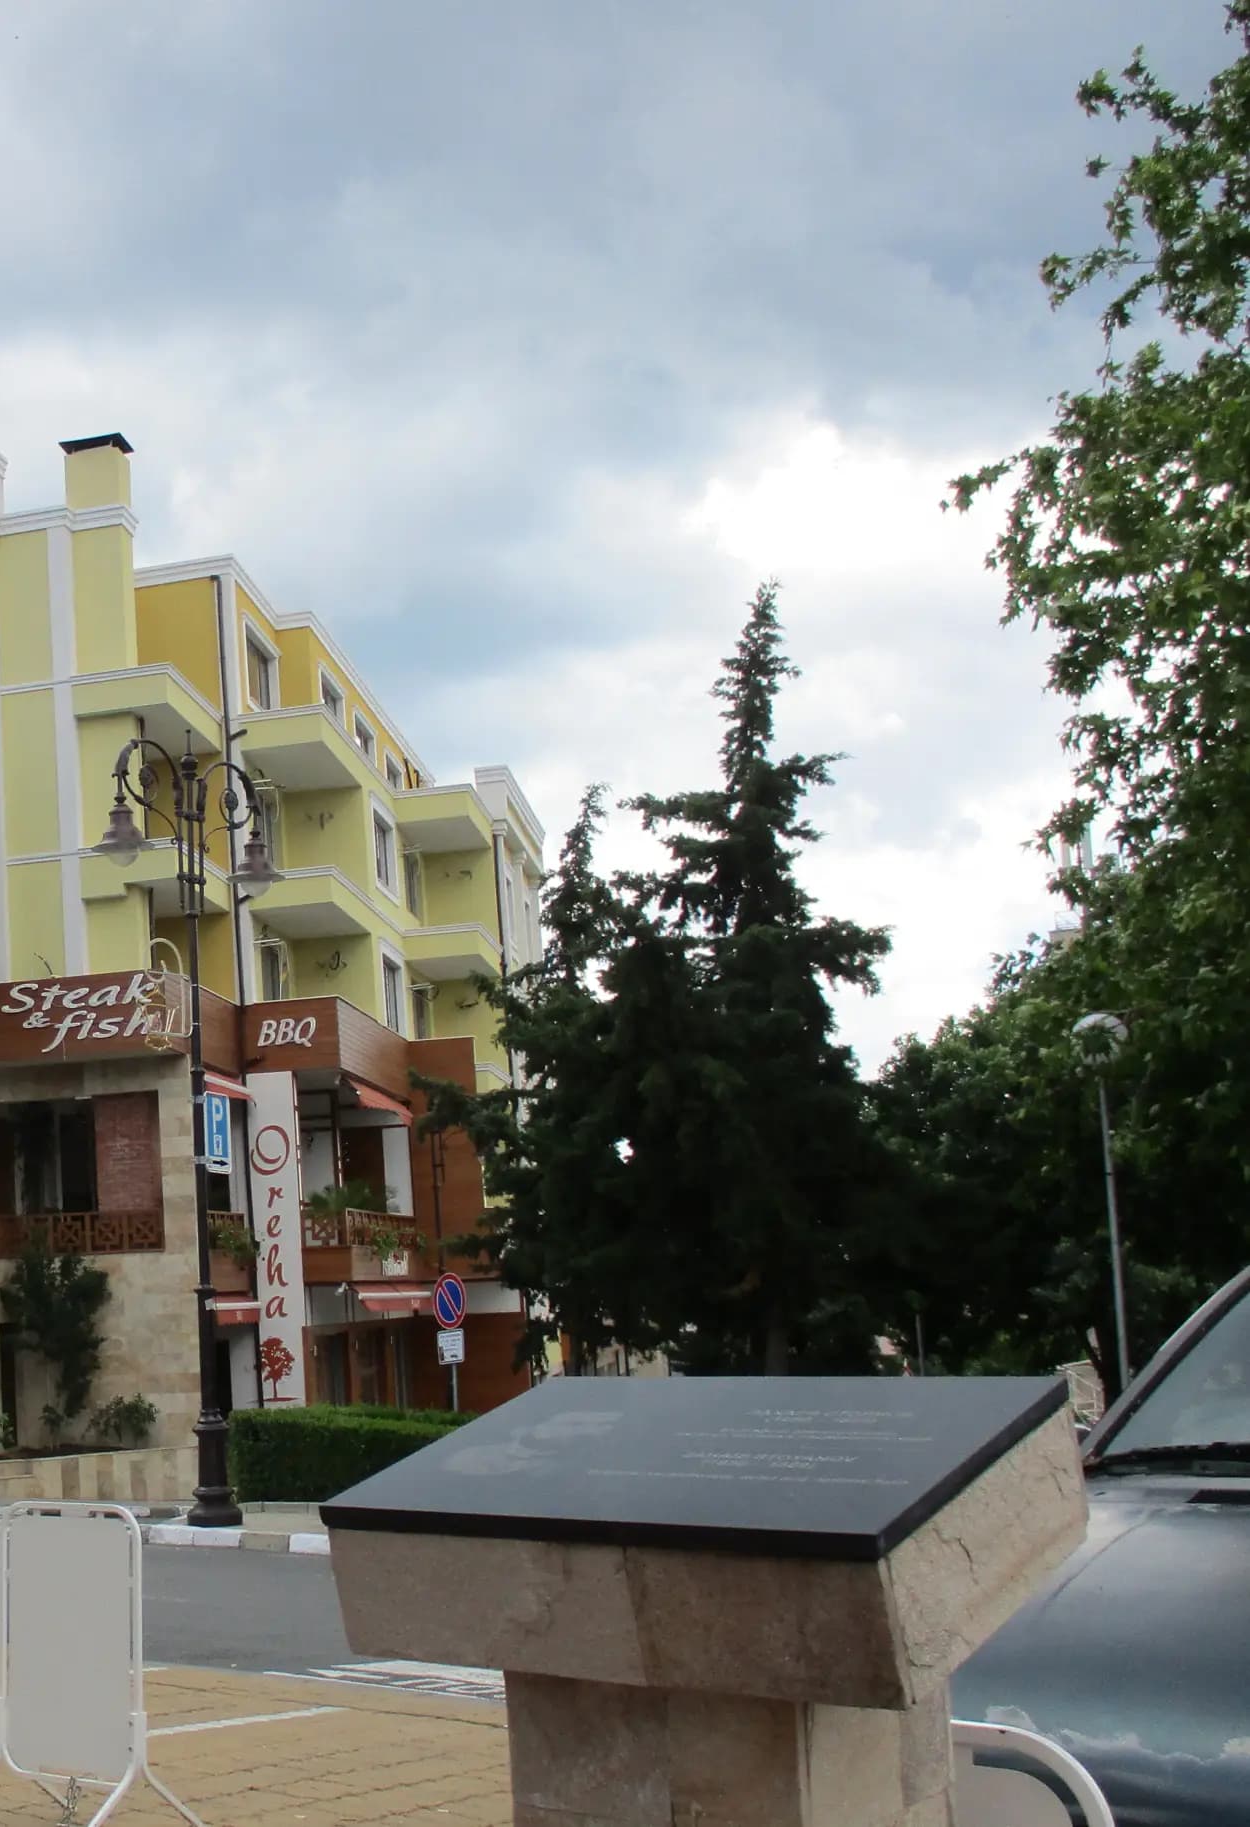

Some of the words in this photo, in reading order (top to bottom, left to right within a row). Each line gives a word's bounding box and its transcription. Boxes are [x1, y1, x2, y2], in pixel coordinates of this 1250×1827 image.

[1, 973, 155, 1014] Steak
[22, 1011, 52, 1029] &
[41, 1007, 150, 1053] fish
[257, 1016, 317, 1048] BBQ
[211, 1097, 224, 1134] P
[251, 1125, 291, 1319] Oreha
